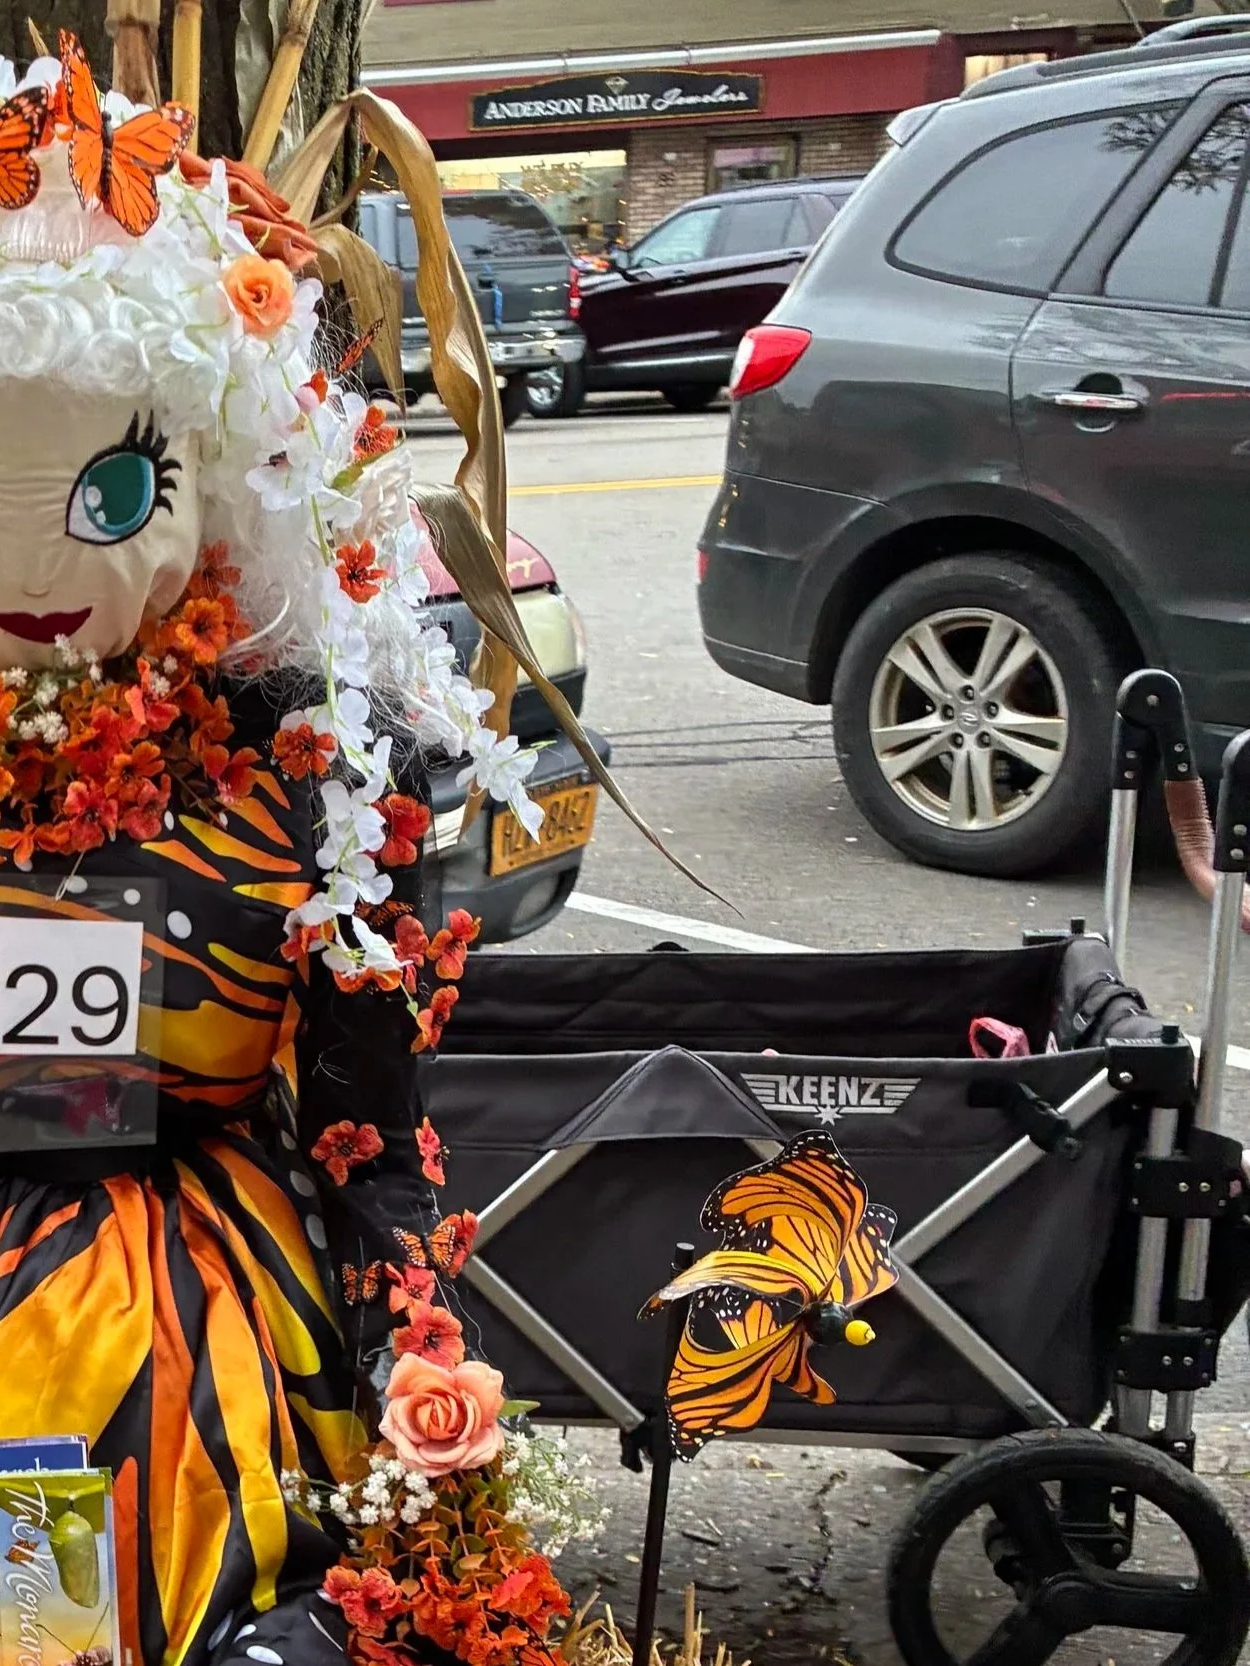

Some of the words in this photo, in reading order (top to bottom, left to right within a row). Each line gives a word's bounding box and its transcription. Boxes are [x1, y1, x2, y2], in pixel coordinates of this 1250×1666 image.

[484, 97, 585, 120] ANDERSON
[586, 93, 652, 114] FAMILY
[651, 83, 750, 112] Jewelers
[2, 964, 130, 1047] 29
[778, 1075, 882, 1107] KEENZ
[5, 1481, 55, 1541] The
